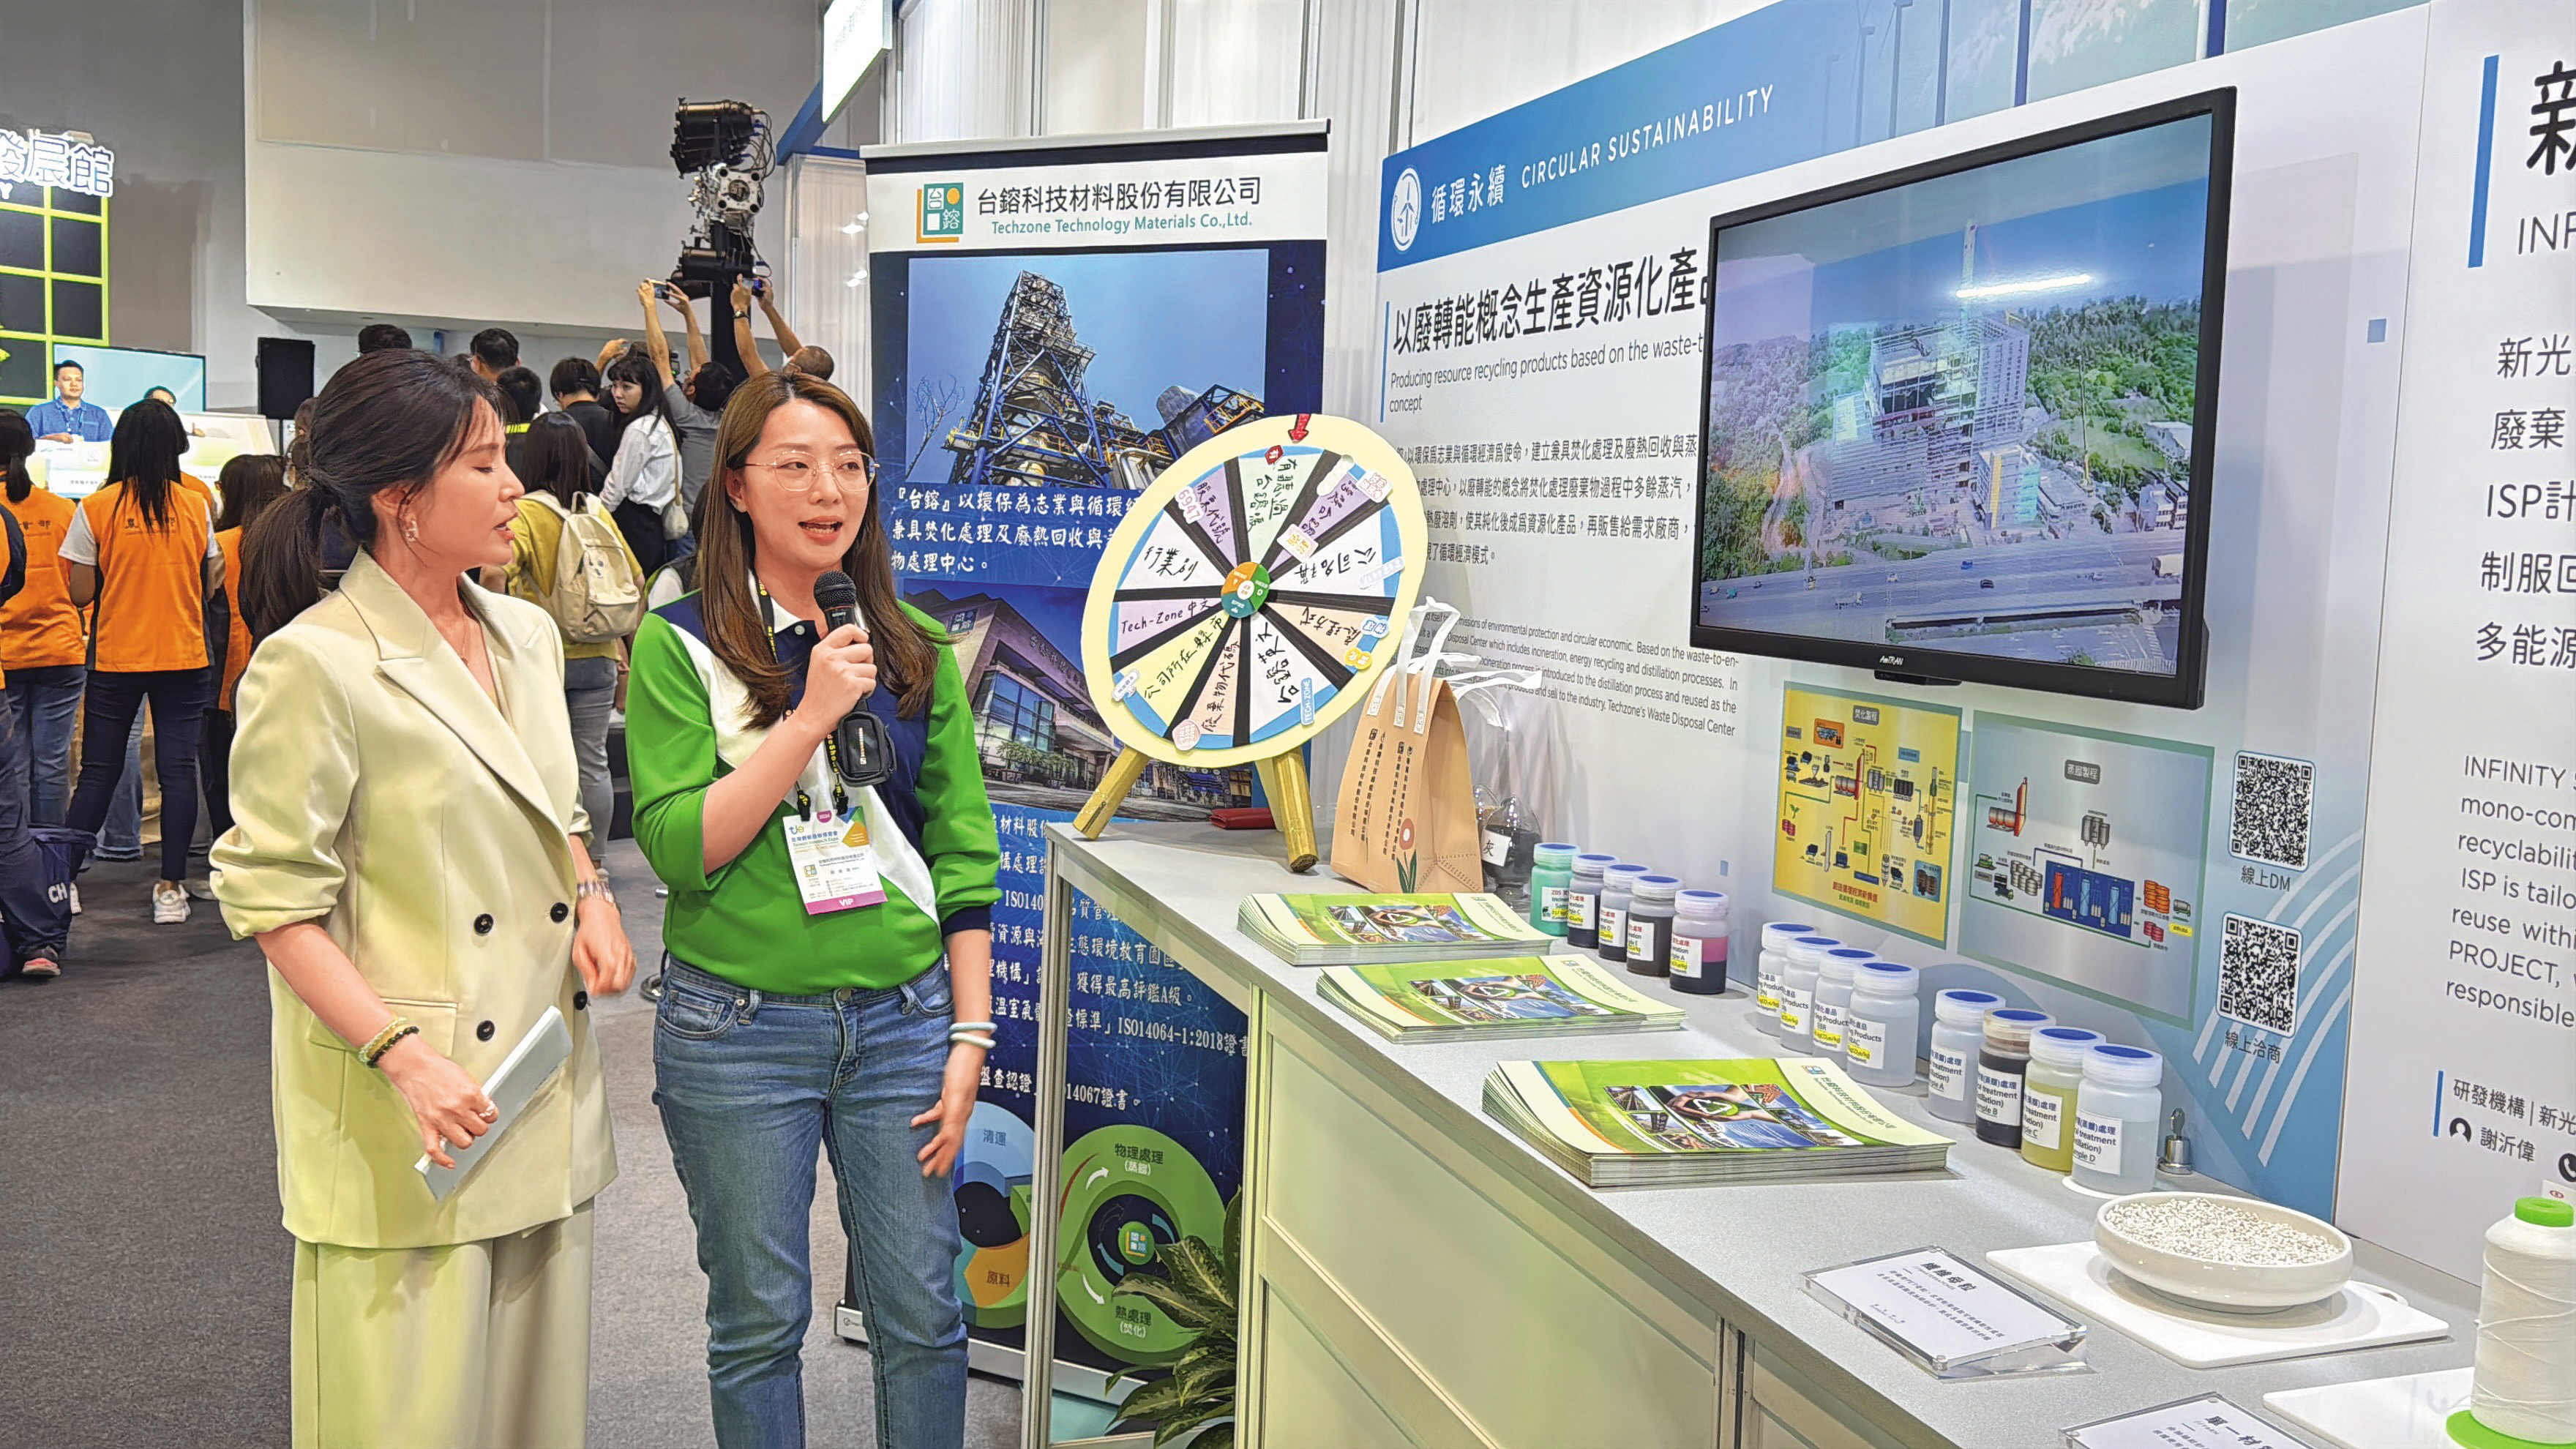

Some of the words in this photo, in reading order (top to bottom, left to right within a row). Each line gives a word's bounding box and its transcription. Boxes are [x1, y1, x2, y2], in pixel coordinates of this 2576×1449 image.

[1521, 143, 1600, 189] CIRCULAR
[1608, 84, 1774, 162] SUSTAINABILITY
[977, 176, 1262, 216] 台鎔科技材料股份有限公司
[1431, 164, 1506, 224] 循環永續
[992, 220, 1052, 235] Techzone
[1055, 217, 1131, 236] Technology
[1134, 214, 1197, 231] Materials
[1199, 211, 1254, 228] Co.,Ltd.
[1390, 368, 1433, 391] Producing
[1434, 364, 1472, 386] resource
[1474, 356, 1518, 384] recycling
[1520, 351, 1568, 379] products
[1570, 345, 1606, 370] based
[1608, 345, 1626, 364] on
[1628, 339, 1649, 363] the
[2496, 333, 2572, 379] 新光
[1390, 396, 1423, 414] concept
[2490, 407, 2566, 450] 廢棄
[1177, 489, 1202, 521] 6947
[2486, 479, 2576, 523] ISP計
[1121, 610, 1183, 634] Tech-Zone
[1300, 606, 1361, 646] 處理方式
[1488, 620, 1527, 636] environmental
[1528, 626, 1559, 640] protection
[1560, 630, 1573, 643] and
[1573, 632, 1597, 647] circular
[1598, 638, 1633, 653] economic.
[1636, 641, 1660, 656] Based
[1660, 646, 1671, 658] on
[1671, 645, 1685, 660] the
[1686, 650, 1740, 669] waste-to-en-
[2476, 621, 2576, 669] 多能源
[1470, 635, 1489, 648] Center
[1489, 637, 1506, 651] which
[1507, 640, 1530, 656] includes
[1532, 645, 1569, 663] incineration,
[1570, 654, 1592, 669] energy
[1594, 656, 1623, 675] recycling
[1626, 662, 1640, 675] and
[1641, 663, 1680, 681] distillation
[1682, 672, 1725, 690] processes.
[1730, 678, 1738, 692] In
[1541, 668, 1576, 685] introduced
[1576, 673, 1584, 685] to
[1584, 674, 1596, 687] the
[1598, 676, 1633, 694] distillation
[1635, 685, 1663, 700] process
[1665, 689, 1680, 703] and
[1681, 692, 1709, 708] reused
[1710, 700, 1721, 711] as
[1723, 700, 1737, 715] the
[1547, 688, 1558, 700] sell
[1559, 691, 1566, 702] to
[1566, 691, 1577, 703] the
[1579, 693, 1606, 711] industry.
[1608, 699, 1646, 719] Techzone's
[1647, 707, 1671, 724] Waste
[1672, 713, 1705, 732] Disposal
[1707, 720, 1736, 738] Center
[2464, 755, 2566, 790] INFINITY
[1483, 840, 1494, 858] 灰
[48, 882, 67, 904] CH
[2240, 864, 2291, 893] 線上DM
[2461, 866, 2497, 892] ISP
[2503, 875, 2520, 899] is
[2527, 880, 2576, 910] tailo
[838, 897, 855, 907] VIP
[2452, 907, 2511, 935] reuse
[2449, 940, 2560, 989] PROJECT,
[1785, 998, 1809, 1009] Products
[1823, 1015, 1849, 1027] Product
[2446, 981, 2575, 1028] responsible
[1854, 1030, 1882, 1043] Products
[2224, 1028, 2282, 1064] 線上洽商
[1982, 1087, 2018, 1100] treatment
[2452, 1078, 2526, 1120] 研發機構
[982, 1128, 1007, 1147] 清運
[1114, 1142, 1164, 1165] 物理處理
[2079, 1131, 2117, 1147] treatment
[2480, 1126, 2536, 1163] 謝沂偉
[986, 1269, 1011, 1288] 原料
[1115, 1305, 1152, 1327] 熱處理
